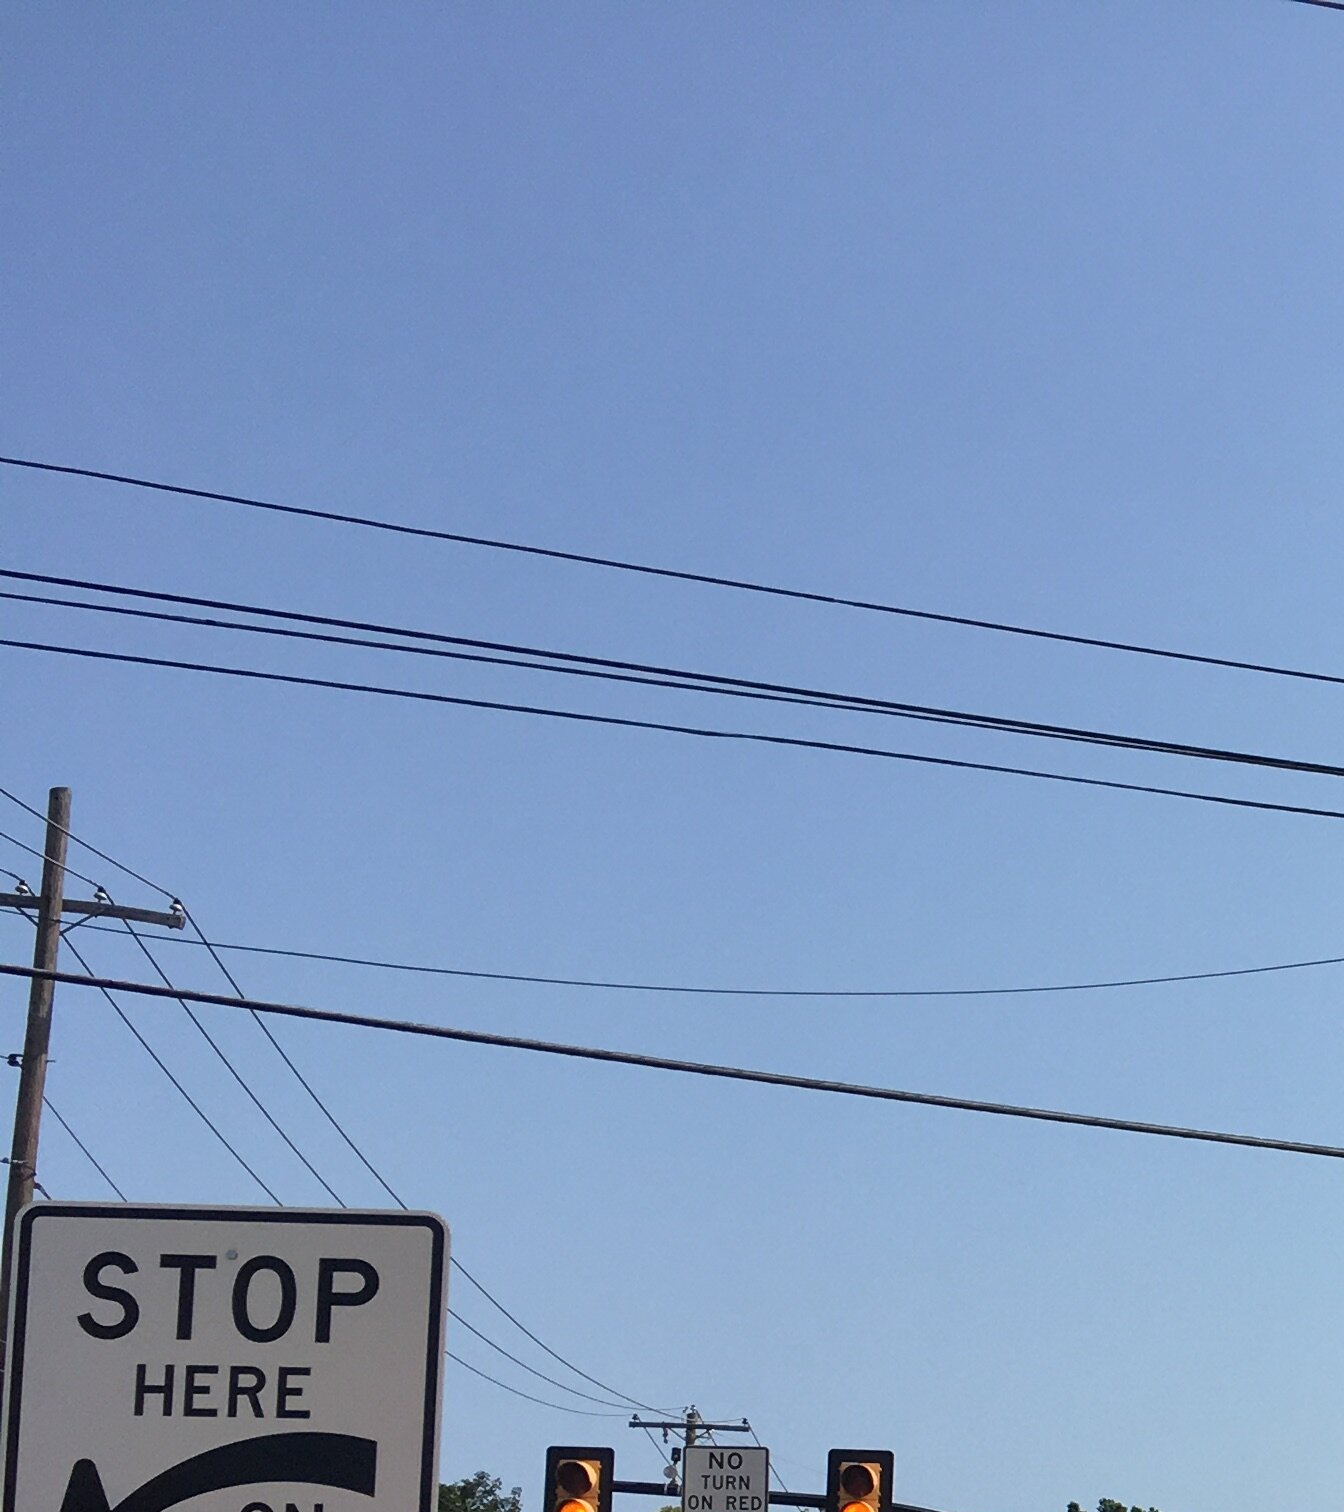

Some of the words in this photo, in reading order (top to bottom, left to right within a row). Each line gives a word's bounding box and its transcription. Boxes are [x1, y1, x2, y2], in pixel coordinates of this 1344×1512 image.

[77, 1250, 380, 1344] STOP
[133, 1363, 312, 1420] HERE
[708, 1452, 743, 1470] NO
[701, 1474, 750, 1490] TURN
[687, 1494, 713, 1510] ON
[725, 1495, 763, 1511] RED
